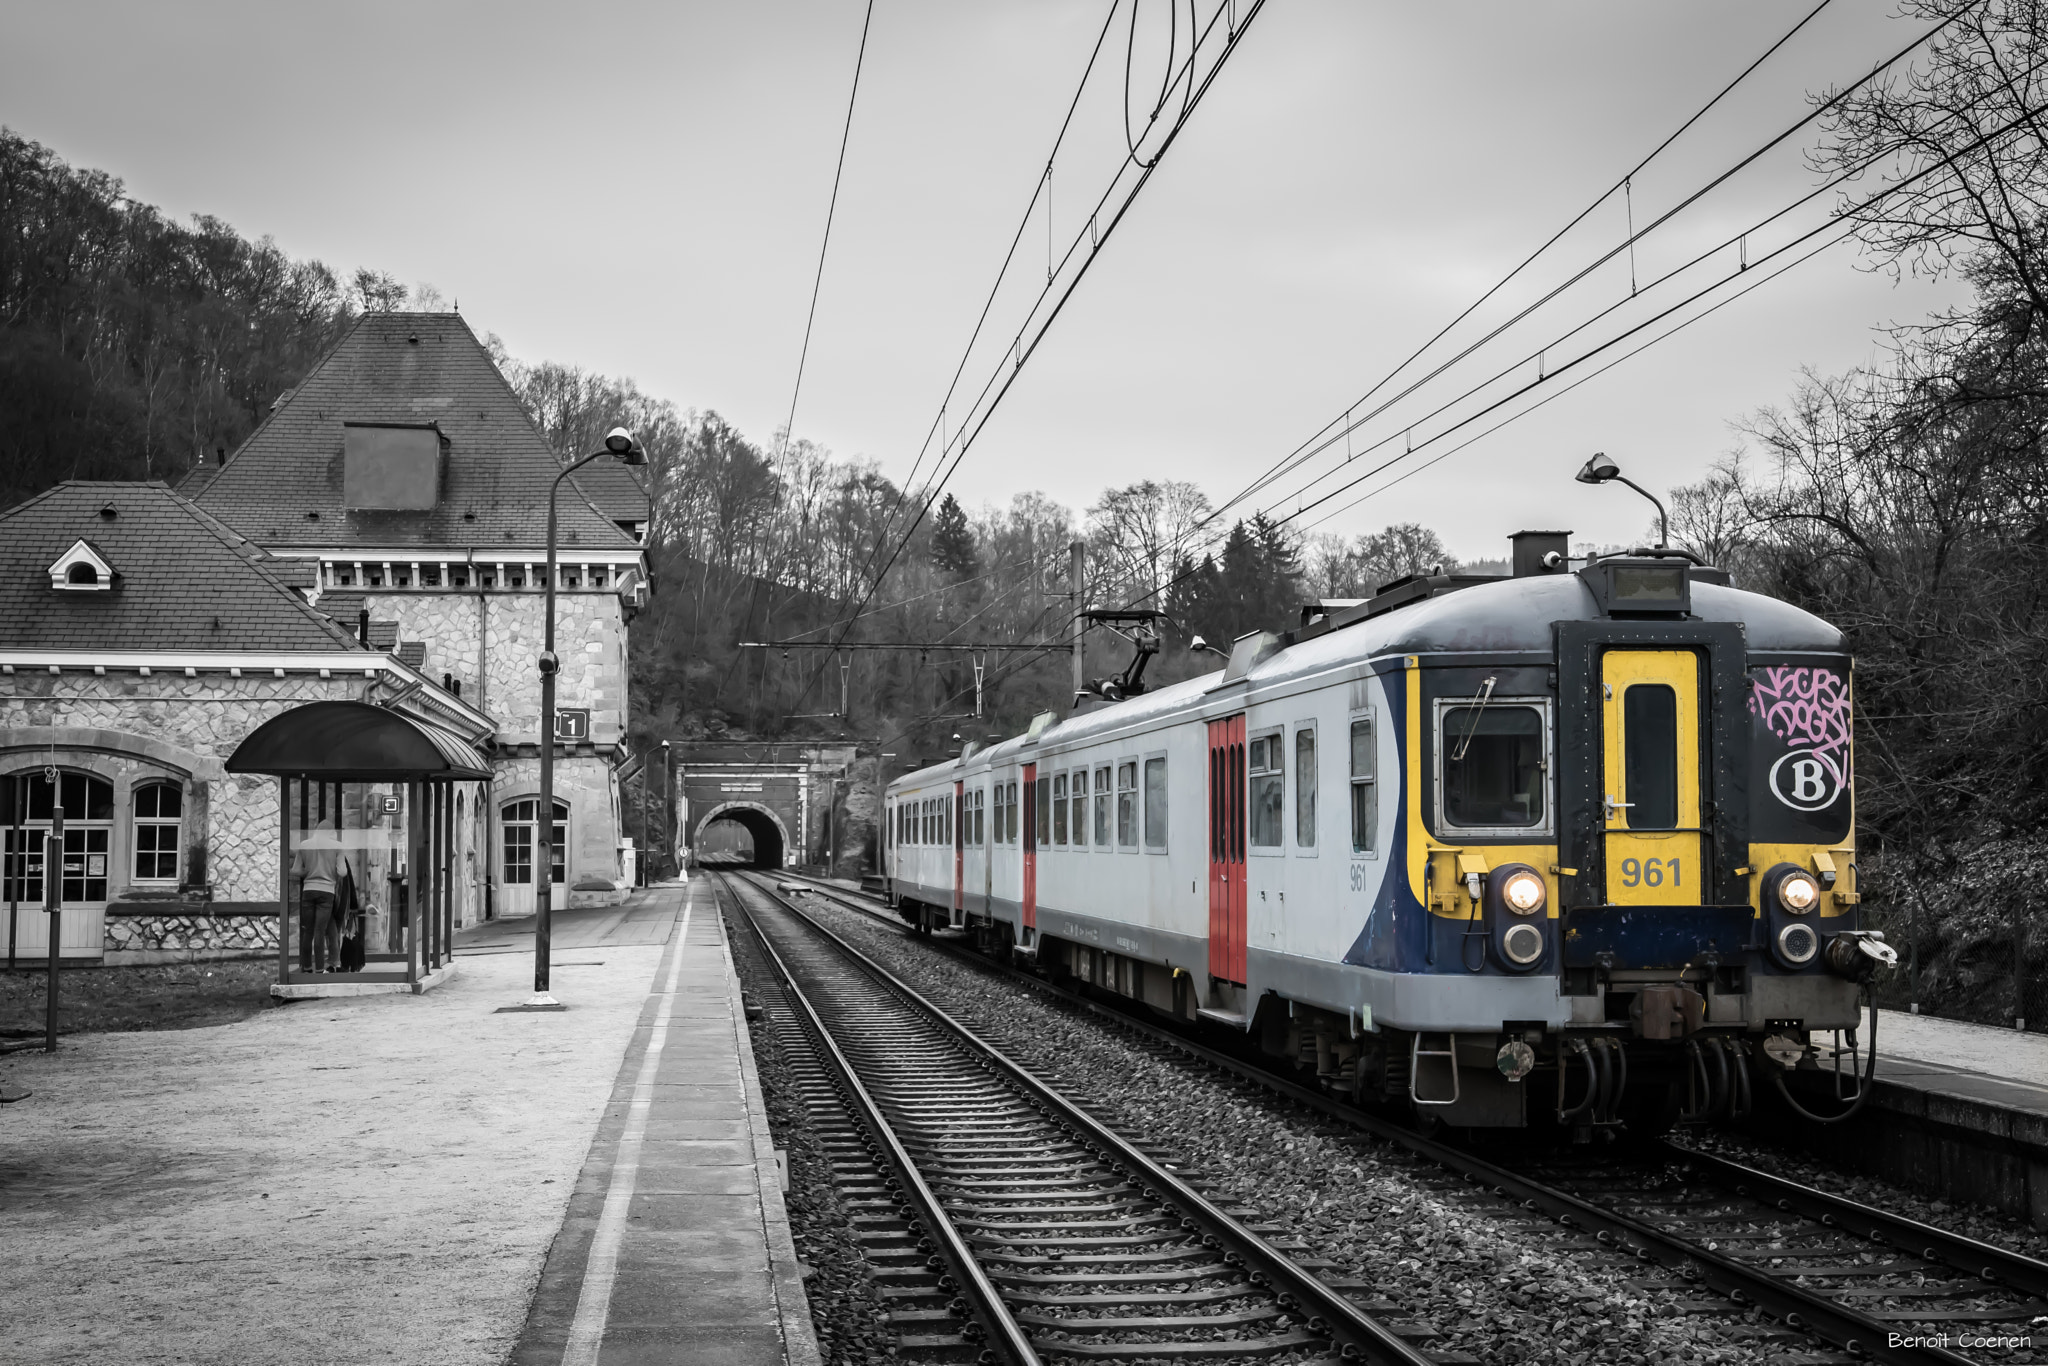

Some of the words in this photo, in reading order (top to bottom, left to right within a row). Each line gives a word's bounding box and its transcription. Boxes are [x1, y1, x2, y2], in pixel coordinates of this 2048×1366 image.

[567, 718, 576, 735] 1
[1791, 759, 1826, 801] B
[1350, 863, 1366, 892] 961
[1621, 857, 1681, 888] 961
